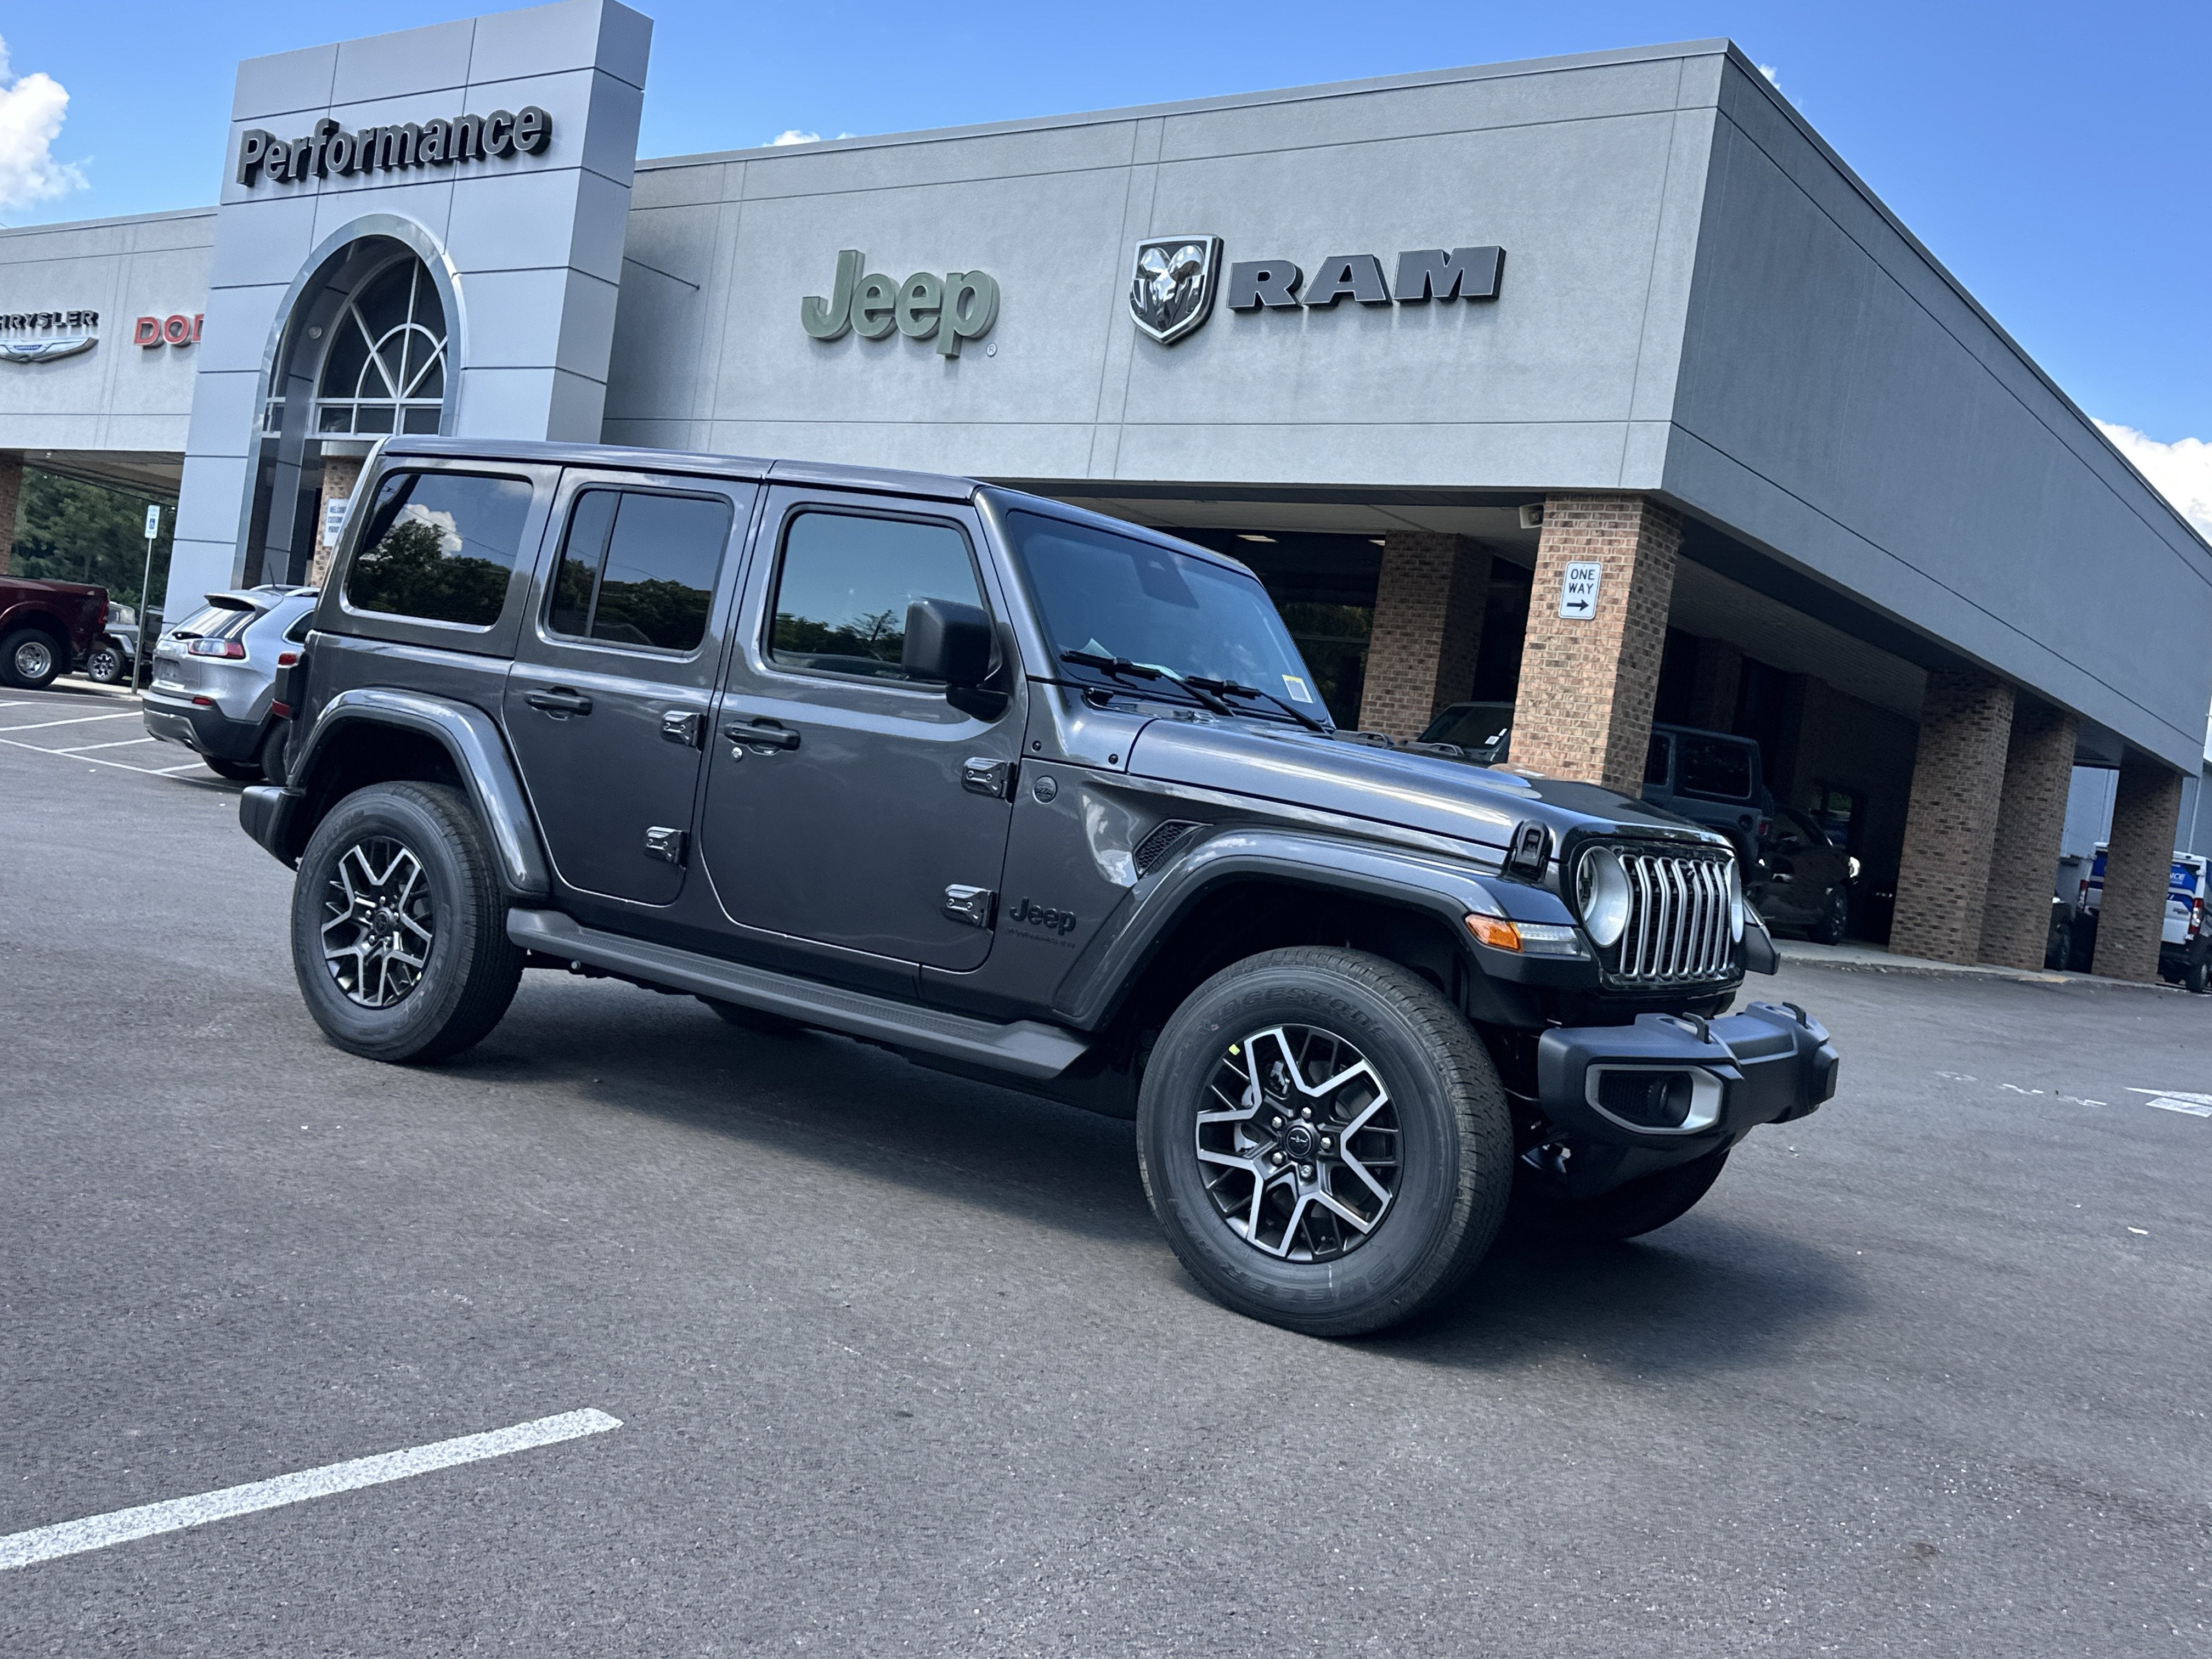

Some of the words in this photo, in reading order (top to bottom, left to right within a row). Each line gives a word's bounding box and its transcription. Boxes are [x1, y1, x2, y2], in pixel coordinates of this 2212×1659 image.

[236, 105, 552, 186] Performance
[801, 250, 1000, 358] Jeep
[1226, 246, 1506, 312] RAM
[1568, 582, 1594, 594] WAY
[1571, 569, 1595, 580] ONE
[1009, 896, 1076, 936] Jeep
